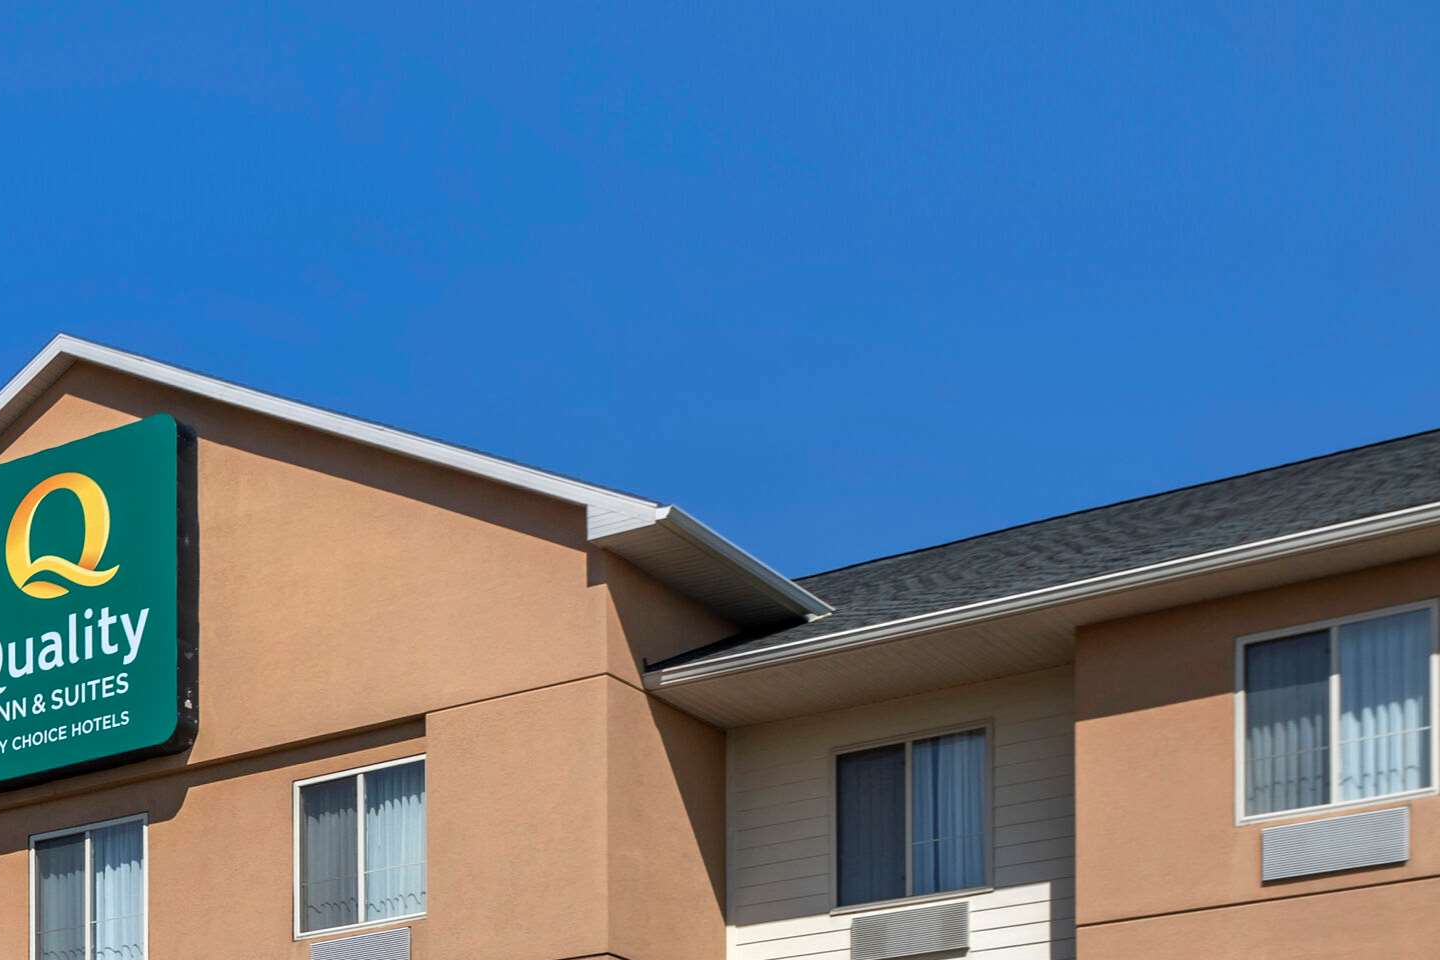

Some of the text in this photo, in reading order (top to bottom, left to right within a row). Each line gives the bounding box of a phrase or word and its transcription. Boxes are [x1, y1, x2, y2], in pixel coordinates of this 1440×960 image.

[6, 472, 120, 599] Q
[32, 693, 46, 715] &
[51, 672, 129, 710] SUITES
[12, 726, 67, 750] CHOICE
[71, 711, 130, 737] HOTELS
